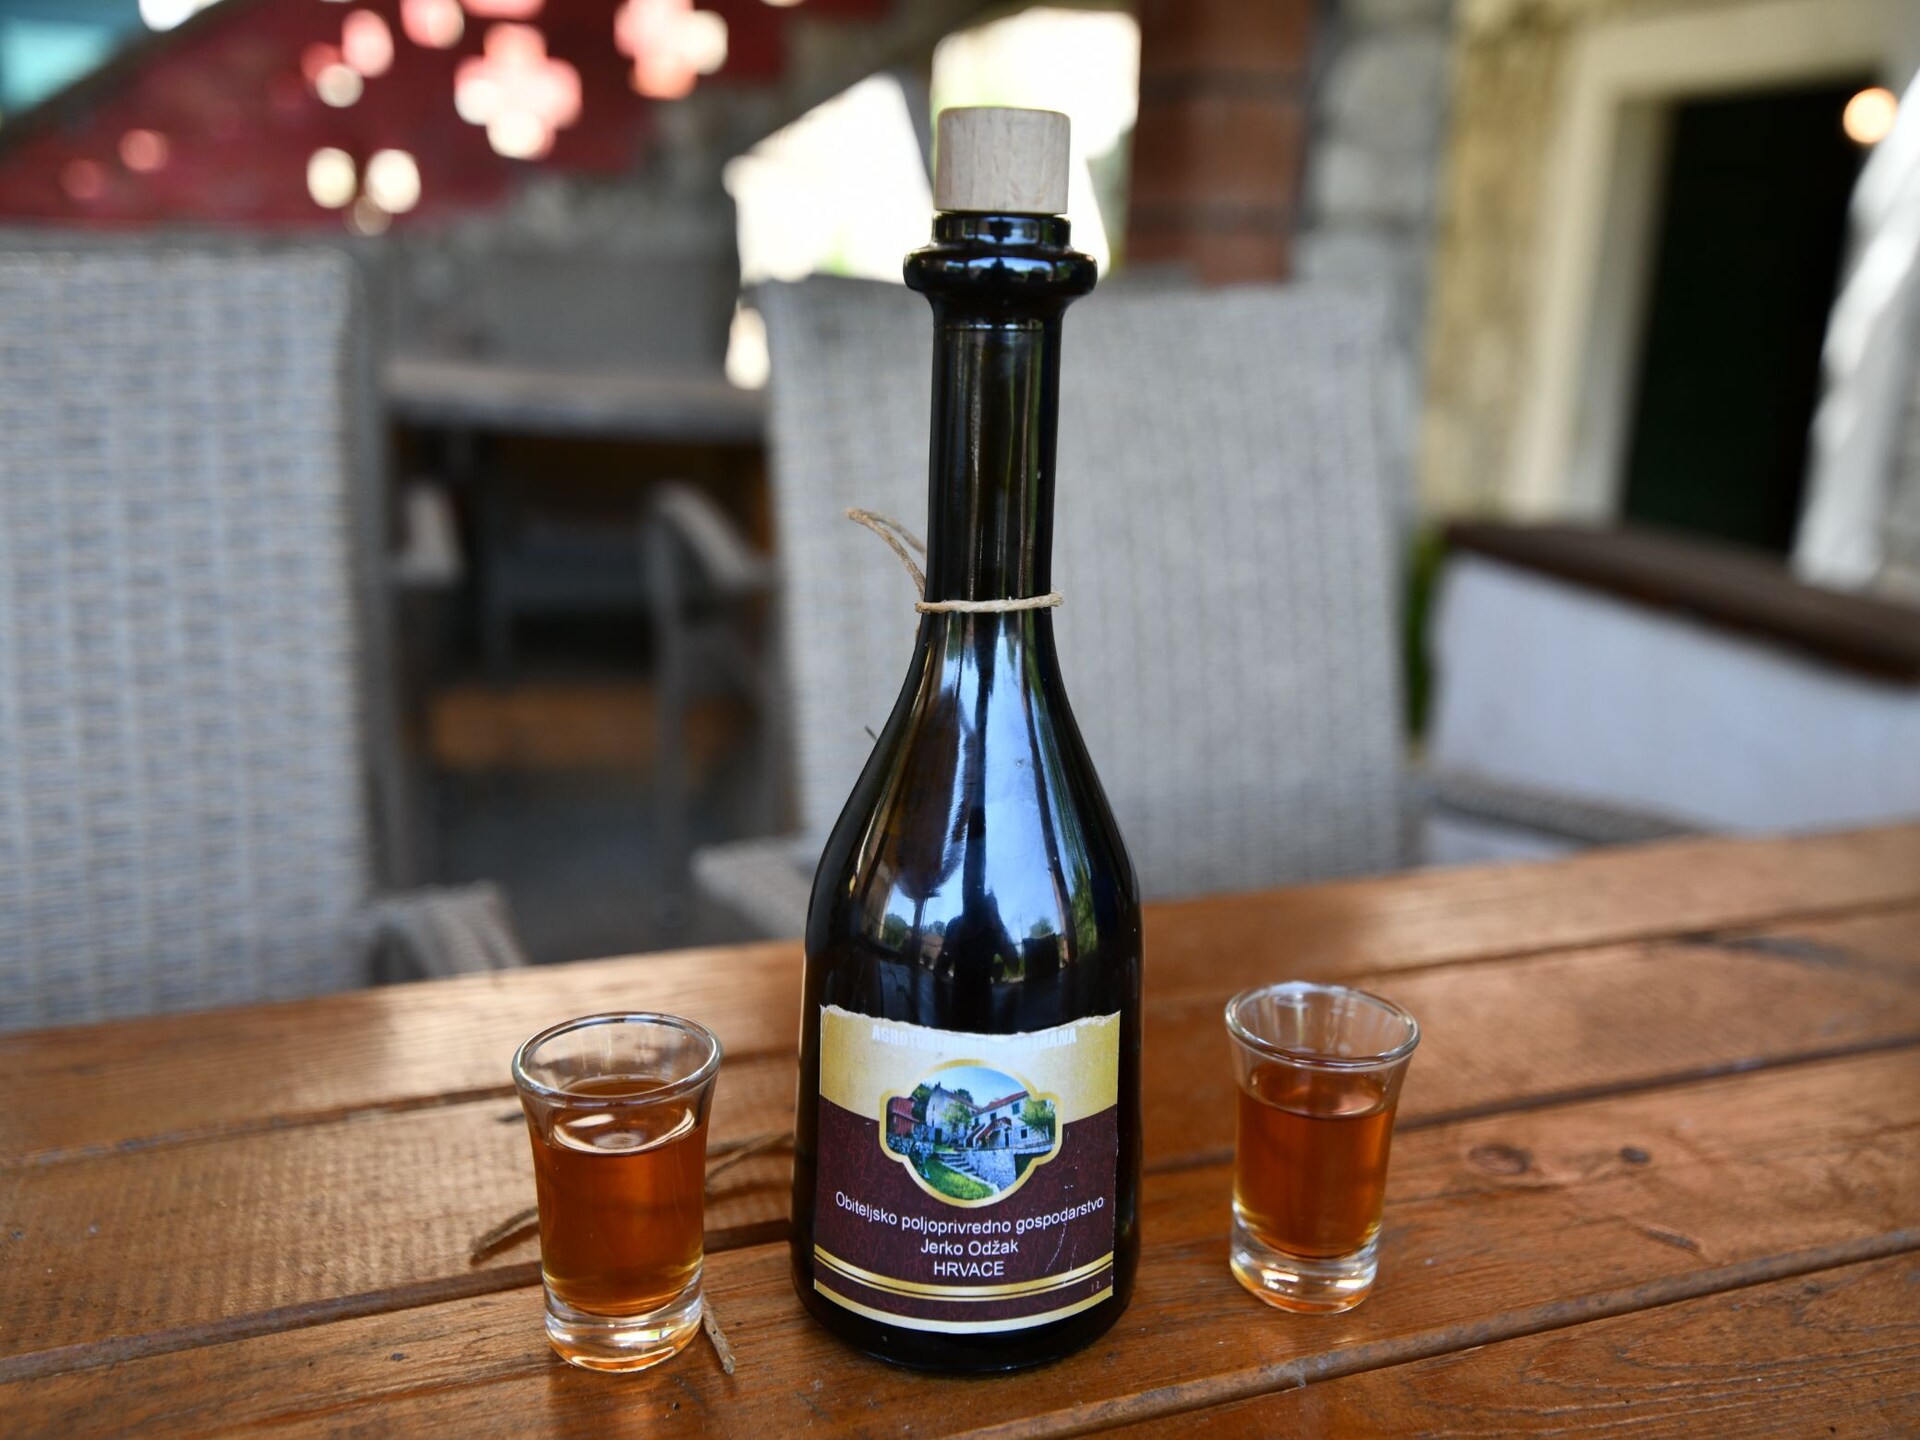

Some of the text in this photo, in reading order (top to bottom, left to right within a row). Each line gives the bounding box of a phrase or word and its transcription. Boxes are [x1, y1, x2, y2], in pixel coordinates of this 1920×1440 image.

[835, 1192, 1105, 1236] Obiteljsko poljoprivredno gospodarstvo
[920, 1239, 1019, 1257] Jerko Odžak
[933, 1260, 1005, 1277] HRVACE
